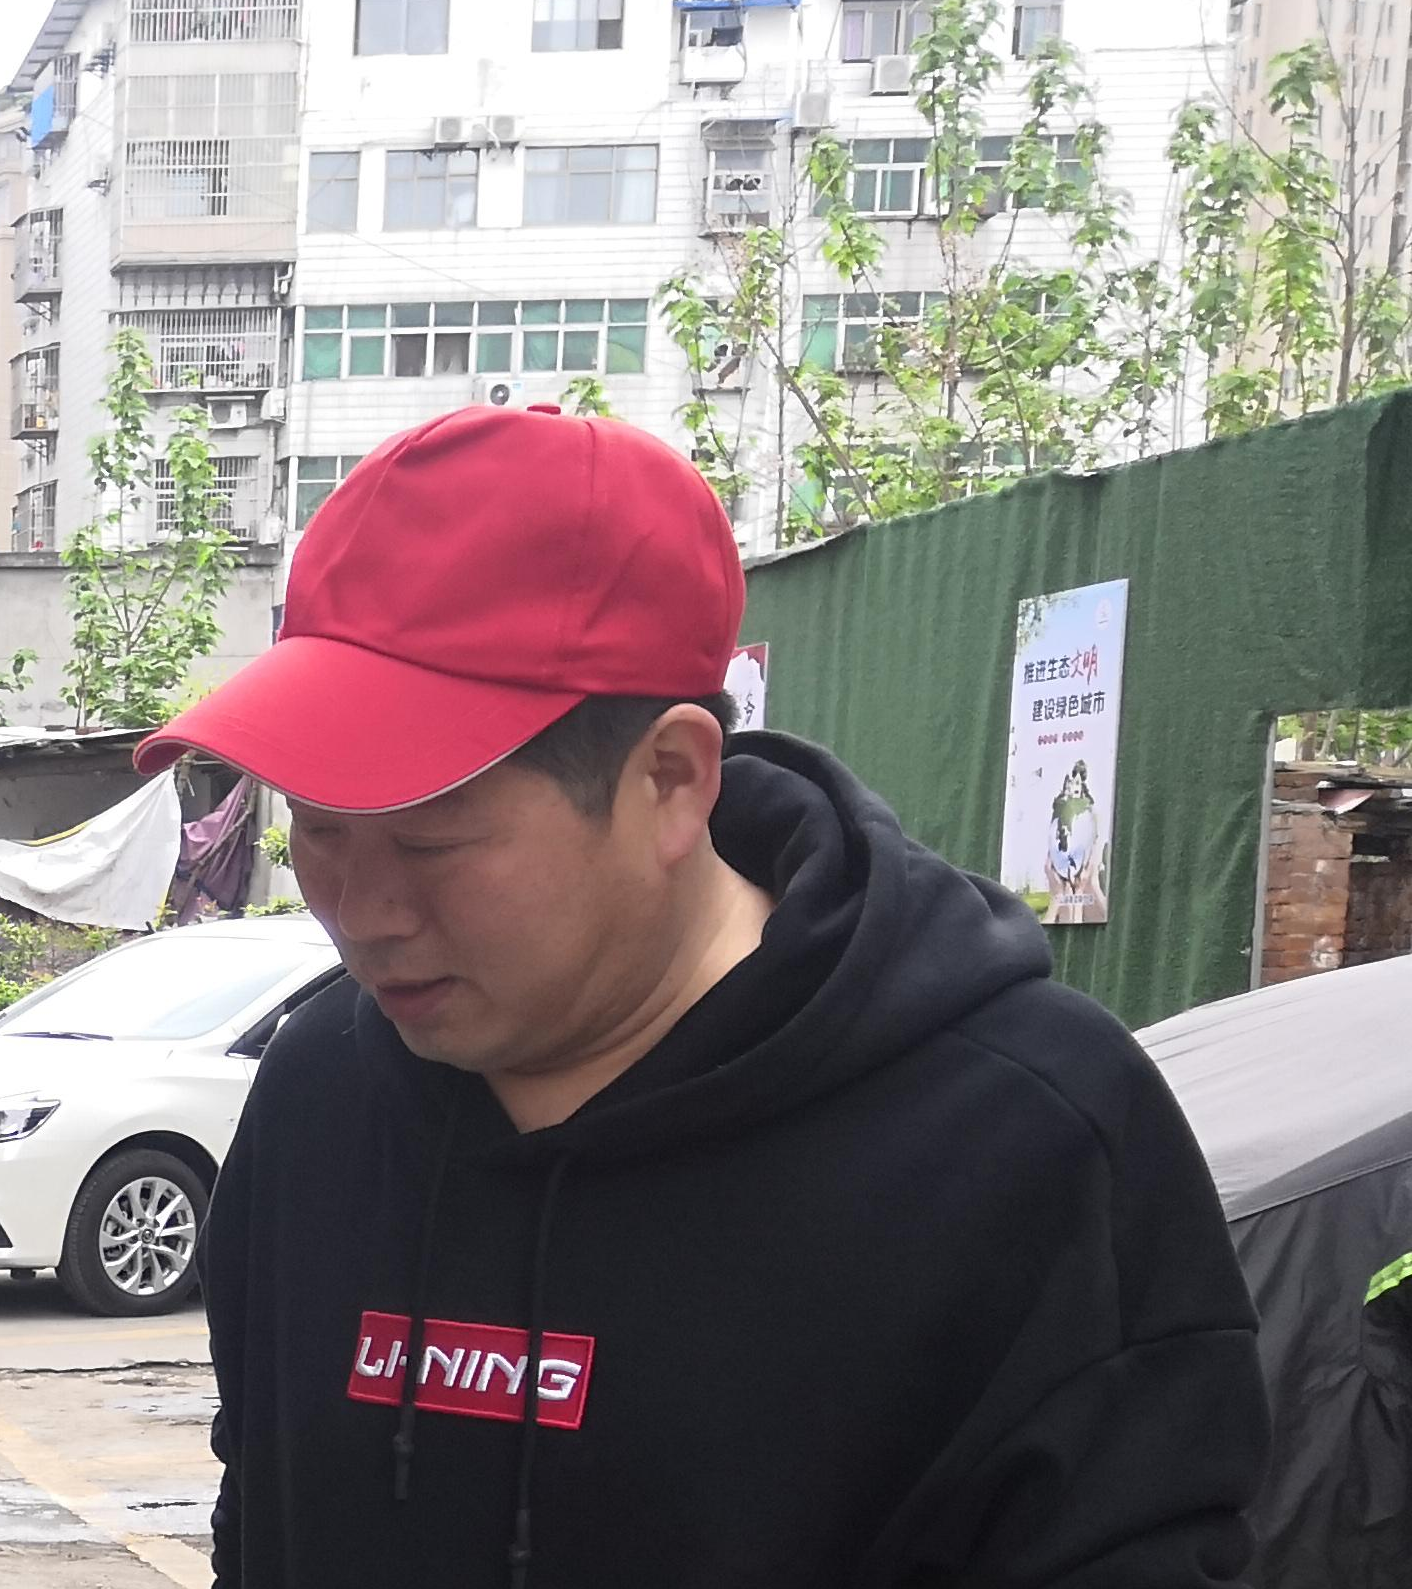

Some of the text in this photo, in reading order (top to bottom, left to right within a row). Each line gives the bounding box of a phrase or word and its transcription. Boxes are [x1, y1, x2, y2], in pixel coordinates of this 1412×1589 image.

[1024, 644, 1097, 685] 推进生态文明
[1032, 691, 1106, 721] 建设绿色城市
